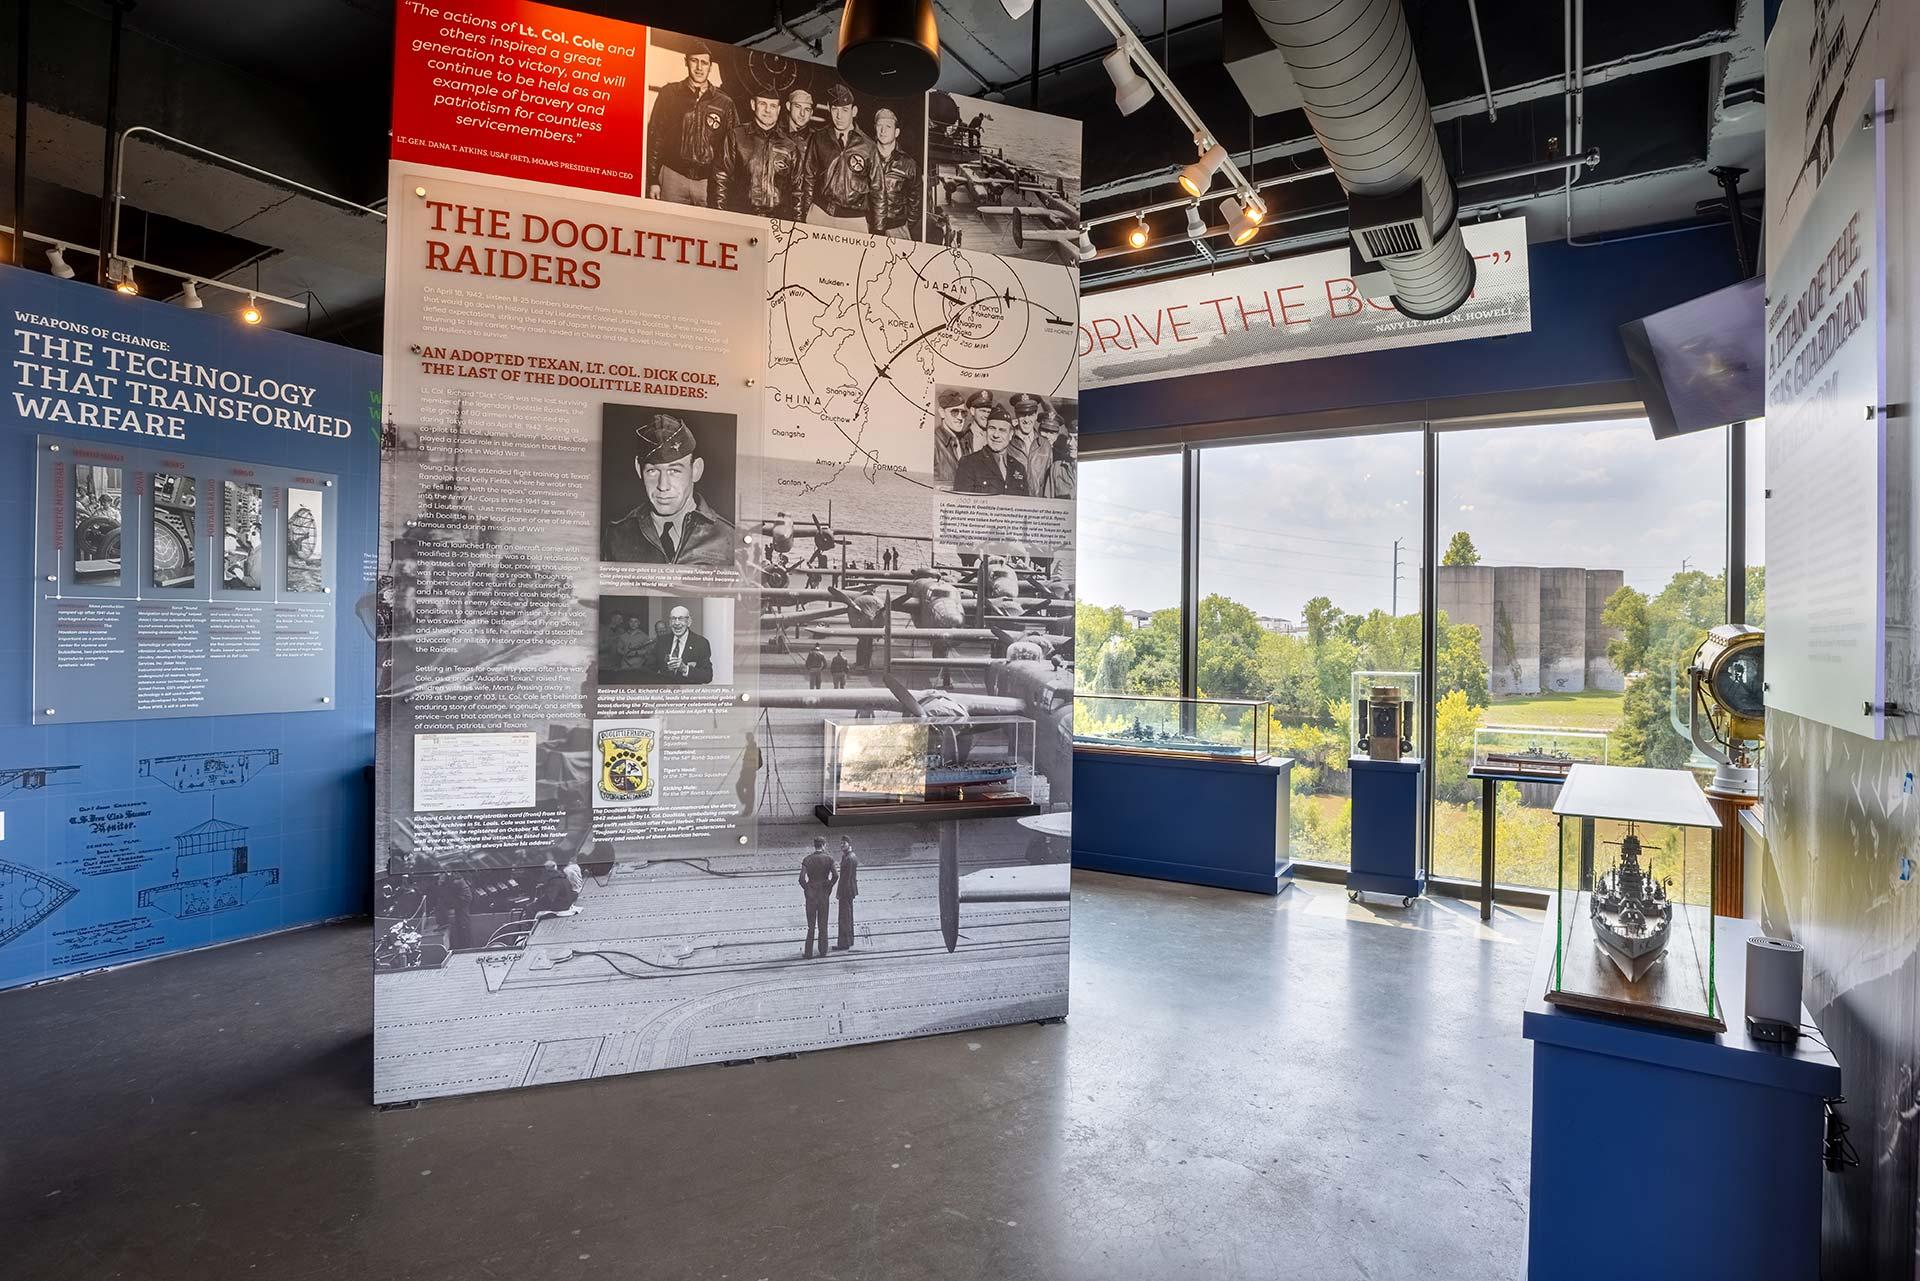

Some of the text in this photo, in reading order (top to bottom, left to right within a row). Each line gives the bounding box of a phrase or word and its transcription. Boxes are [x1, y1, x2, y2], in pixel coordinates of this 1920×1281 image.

[405, 0, 634, 58] “The actions of Lt. Col. Cole and
[440, 25, 600, 67] others inspired a great
[412, 38, 625, 88] generation to victory, and will
[427, 58, 610, 101] continue to be held as an
[432, 76, 604, 116] example of bravery and
[434, 93, 601, 131] patriotism for countless
[456, 114, 581, 143] servicemembers.”
[397, 134, 407, 143] LT.
[428, 140, 450, 150] DANA
[451, 143, 457, 151] T.
[489, 150, 509, 160] USAF
[560, 161, 599, 175] PRESIDENT
[601, 168, 617, 178] AND
[618, 171, 633, 180] CEO
[425, 199, 738, 271] THE DOOLITTLE
[812, 232, 876, 248] MANCHUKUO
[425, 239, 601, 290] RAIDERS
[819, 278, 844, 286] Mukden
[924, 280, 967, 294] JAPAN
[1776, 290, 1807, 368] TITAN
[1808, 263, 1827, 322] OF
[1827, 212, 1860, 296] THE
[975, 311, 1004, 320] Yokohama
[979, 304, 999, 313] TOKYO
[1080, 303, 1199, 358] DRIVE
[1200, 284, 1311, 334] THE
[1405, 320, 1420, 328] LT.
[1466, 307, 1515, 320] HOWELL
[14, 310, 170, 352] WEAPONS OF CHANGE:
[888, 320, 914, 328] KOREA
[954, 328, 972, 336] Osaka
[960, 320, 982, 329] Nagoya
[1794, 269, 1868, 395] GUARDIAN
[799, 339, 811, 352] River
[14, 329, 316, 407] THE TECHNOLOGY
[422, 346, 719, 386] AN ADOPTED TEXAN, LT. COL. DICK COLE,
[422, 362, 707, 398] THE LAST OF THE DOOLITTLE RAIDERS:
[826, 387, 856, 397] Shanghai
[13, 360, 352, 439] THAT TRANSFORMED
[774, 393, 821, 405] CHINA
[13, 392, 186, 439] WARFARE
[820, 414, 850, 423] Chuchow
[419, 433, 444, 443] played
[558, 443, 585, 452] became
[772, 429, 805, 438] Changsha
[418, 462, 442, 472] Young
[478, 466, 511, 475] attended
[512, 468, 531, 478] flight
[532, 470, 559, 480] training
[816, 459, 835, 467] Amoy
[873, 464, 907, 472] FORMOSA
[458, 694, 472, 702] age
